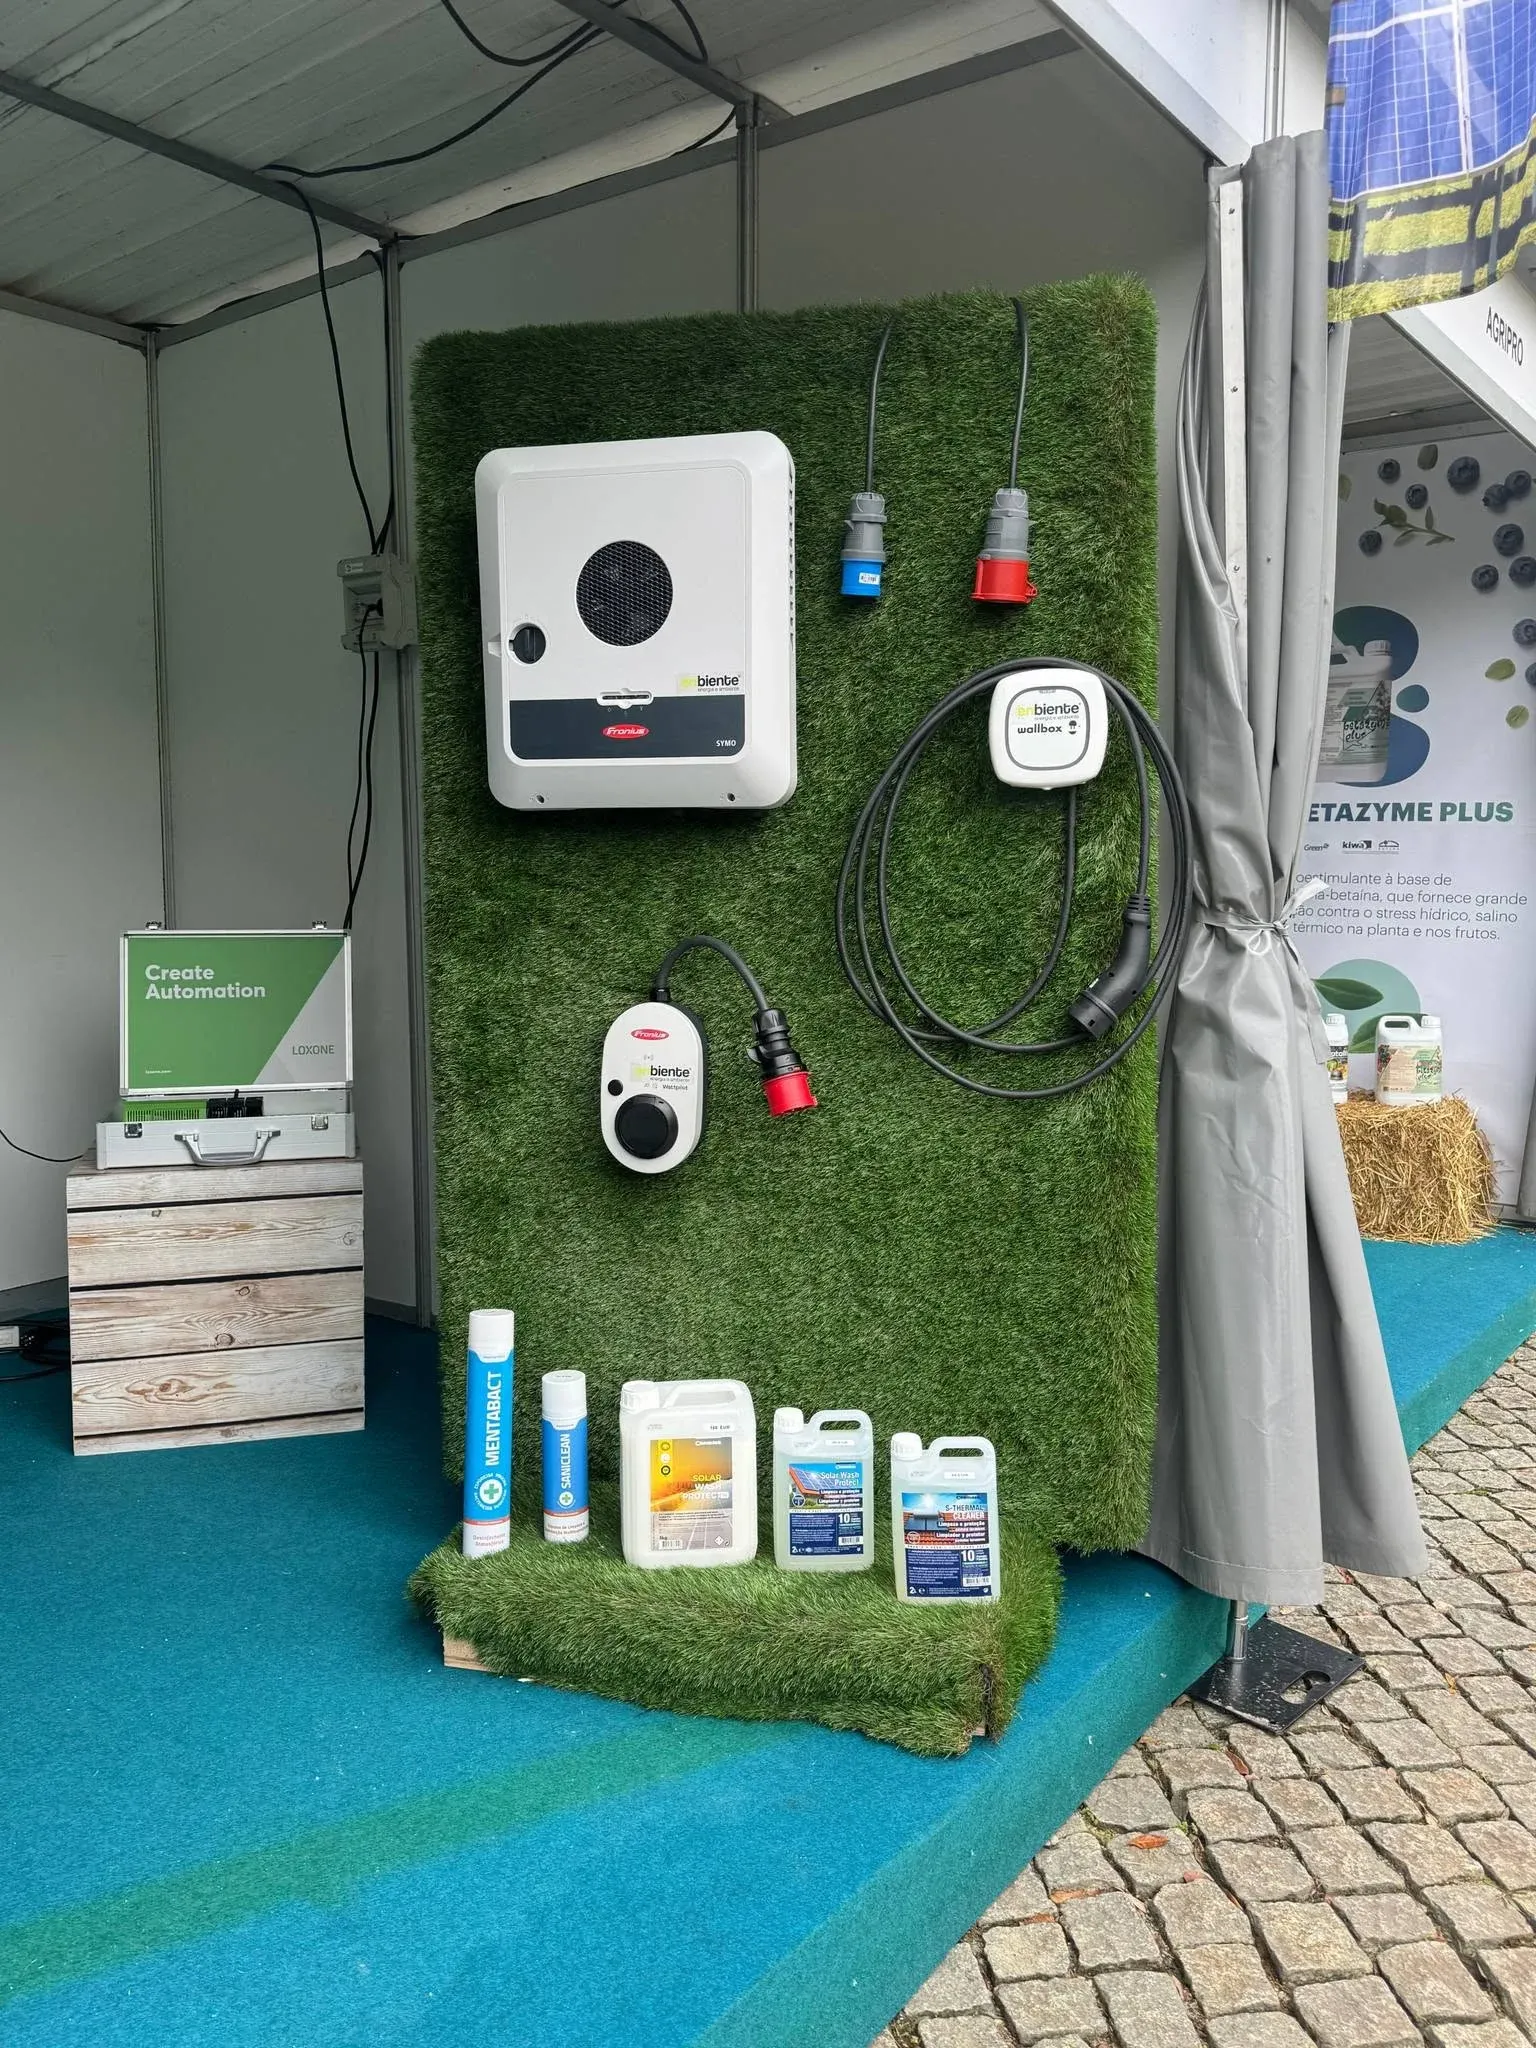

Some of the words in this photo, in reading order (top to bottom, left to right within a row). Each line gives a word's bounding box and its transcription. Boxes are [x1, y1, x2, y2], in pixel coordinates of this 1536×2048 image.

[1486, 306, 1523, 366] AGRIPRO
[606, 726, 646, 736] Fronius
[1018, 724, 1062, 734] wallbox
[1440, 802, 1513, 822] PLUS
[1398, 872, 1430, 886] base
[1434, 874, 1452, 886] de
[1387, 892, 1414, 904] que
[1418, 890, 1472, 903] fornece
[1476, 892, 1528, 906] grande
[1317, 908, 1360, 918] contra
[1364, 909, 1372, 918] o
[1376, 908, 1416, 919] stress
[1420, 908, 1471, 922] hídrico,
[1476, 909, 1518, 922] salino
[1294, 921, 1344, 934] térmico
[1347, 925, 1363, 934] na
[1368, 924, 1409, 937] planta
[1414, 928, 1422, 936] e
[1426, 928, 1451, 938] nos
[1455, 926, 1500, 940] frutos.
[145, 964, 214, 980] Create
[145, 982, 266, 1000] Automation
[292, 1045, 335, 1056] LOXONE
[635, 1065, 690, 1078] biente
[486, 1371, 502, 1466] MENTABACT
[560, 1434, 572, 1489] SANICLEAN
[838, 1514, 850, 1524] 10
[962, 1550, 975, 1561] 10
